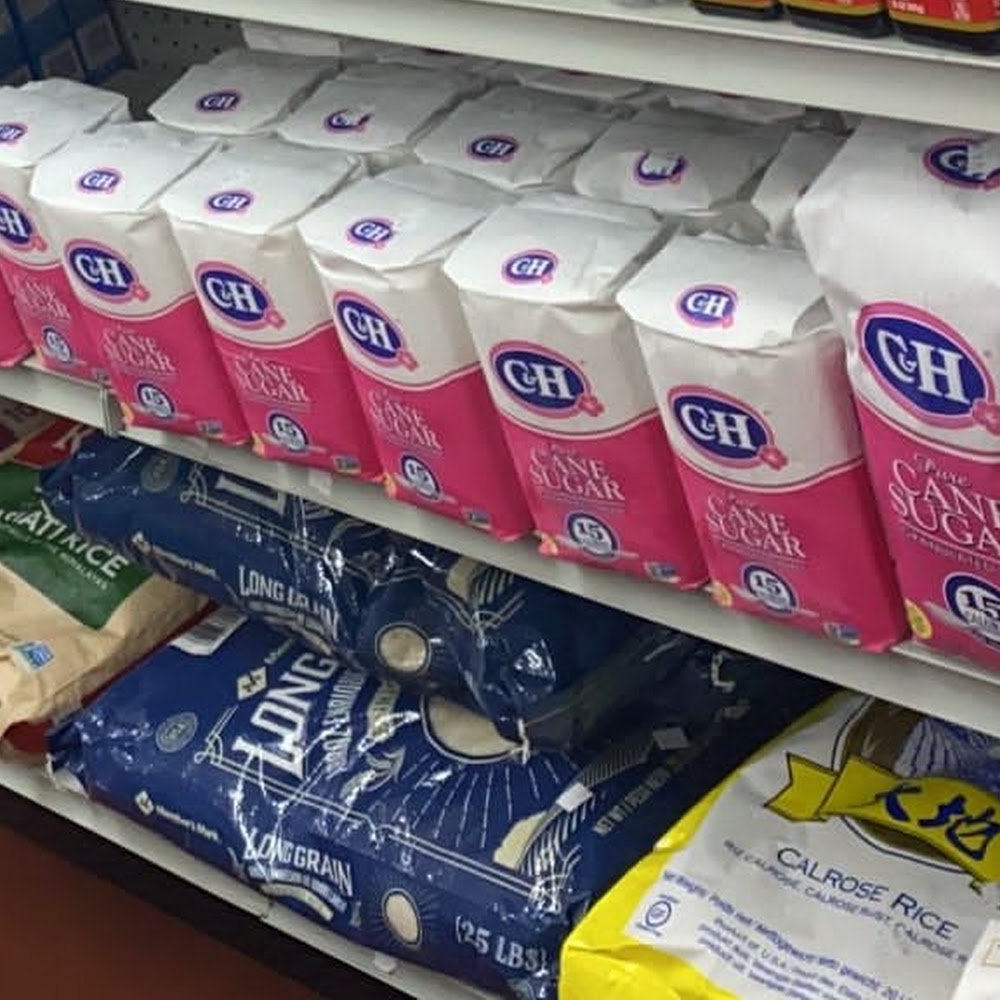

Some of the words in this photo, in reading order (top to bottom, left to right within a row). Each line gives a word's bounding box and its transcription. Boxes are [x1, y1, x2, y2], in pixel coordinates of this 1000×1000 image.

[74, 253, 129, 290] C&H
[204, 276, 262, 315] C&H
[685, 291, 730, 318] C&H
[341, 307, 394, 354] C&H
[503, 359, 577, 401] C&H
[875, 327, 967, 404] C&H
[678, 402, 758, 452] C&H
[528, 462, 626, 501] SUGAR
[529, 445, 608, 481] CANE
[706, 512, 808, 560] SUGAR
[707, 494, 791, 536] CANE
[888, 483, 1000, 558] SUGA
[238, 564, 285, 604] LONG
[753, 570, 786, 595] 15
[231, 651, 341, 780] LONG
[294, 848, 354, 897] GRAIN
[777, 847, 890, 903] CALROSE
[891, 891, 960, 941] RICE
[455, 914, 490, 955] (25
[497, 937, 548, 977] LBS)
